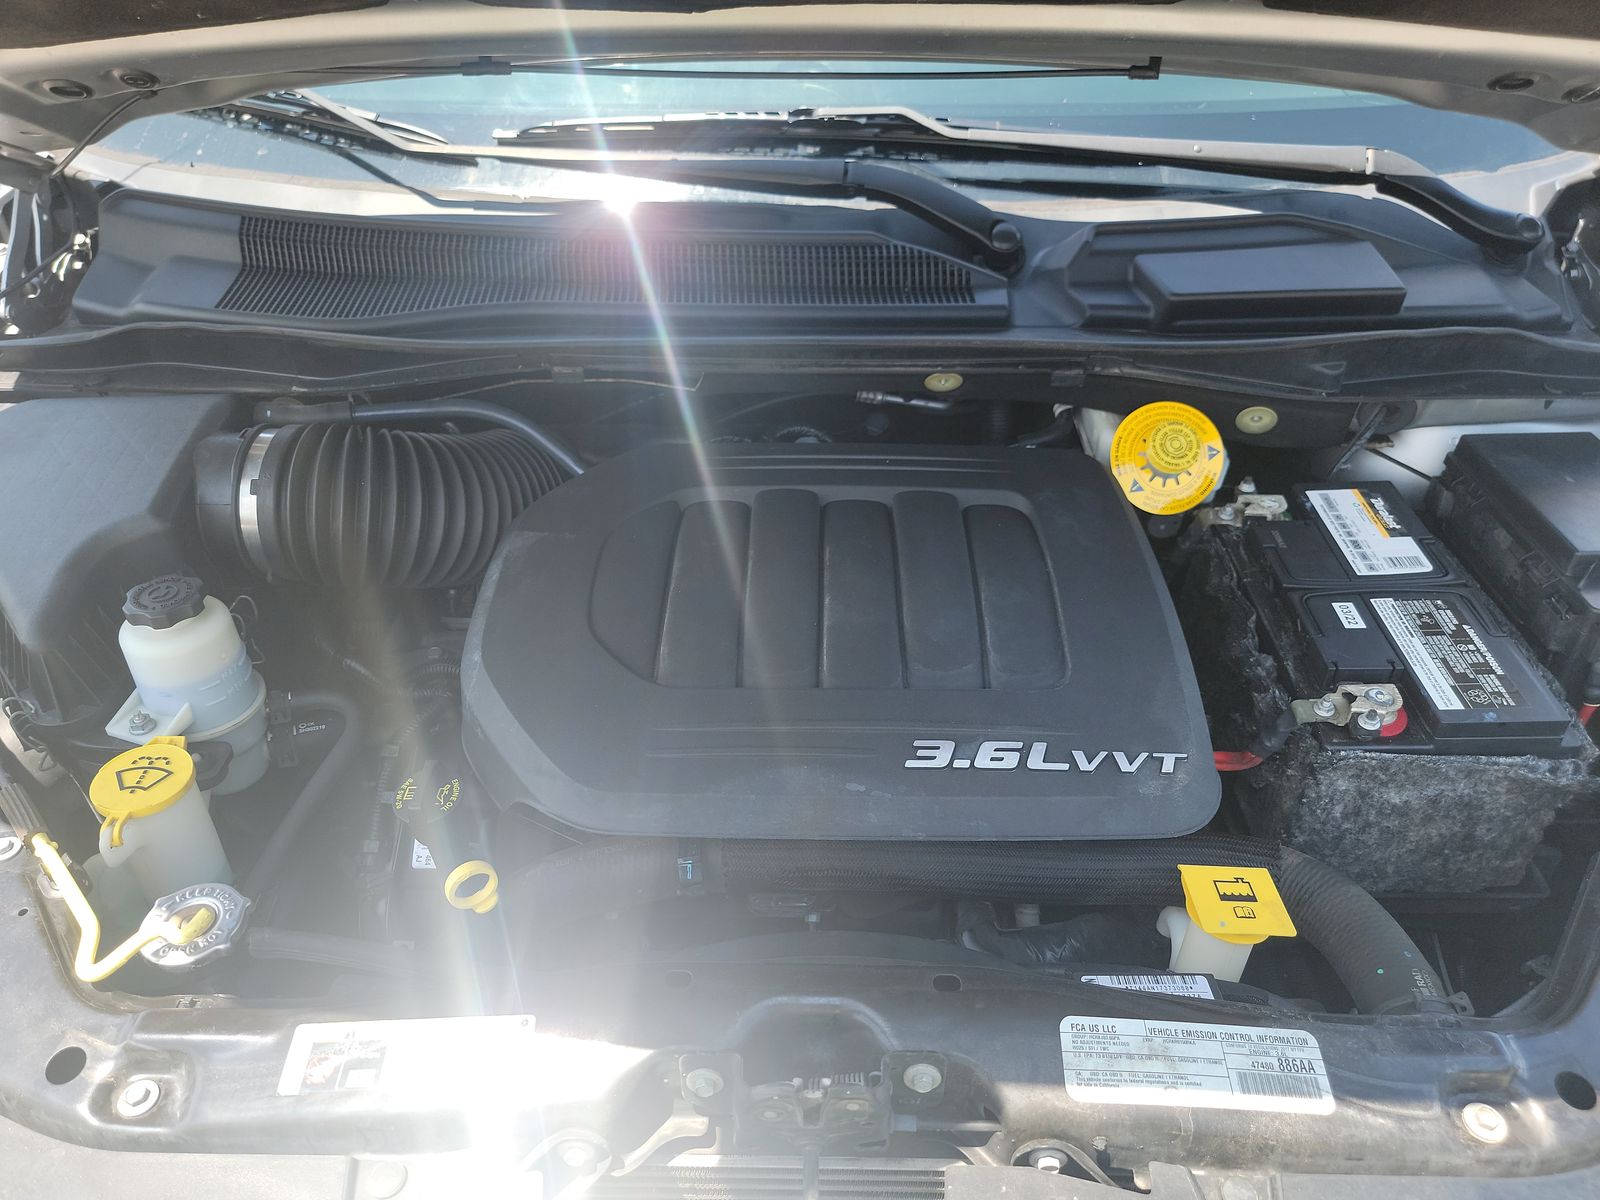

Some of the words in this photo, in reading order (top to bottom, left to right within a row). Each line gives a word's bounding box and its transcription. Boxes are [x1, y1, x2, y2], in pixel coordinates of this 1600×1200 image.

[1339, 604, 1359, 626] 03/22
[904, 739, 1070, 771] 3.6L
[1072, 750, 1188, 773] VVT
[450, 778, 460, 801] ENGINE
[440, 801, 453, 811] OIL
[1070, 1023, 1086, 1032] FCA
[1088, 1023, 1100, 1033] US
[1102, 1024, 1117, 1034] LLC
[1147, 1027, 1180, 1037] VEHICLE
[1181, 1029, 1218, 1040] EMISSION
[1219, 1031, 1255, 1042] CONTROL
[1256, 1034, 1309, 1046] INFORMATION
[1251, 1061, 1275, 1070] 47480
[1277, 1057, 1316, 1074] 886AA
